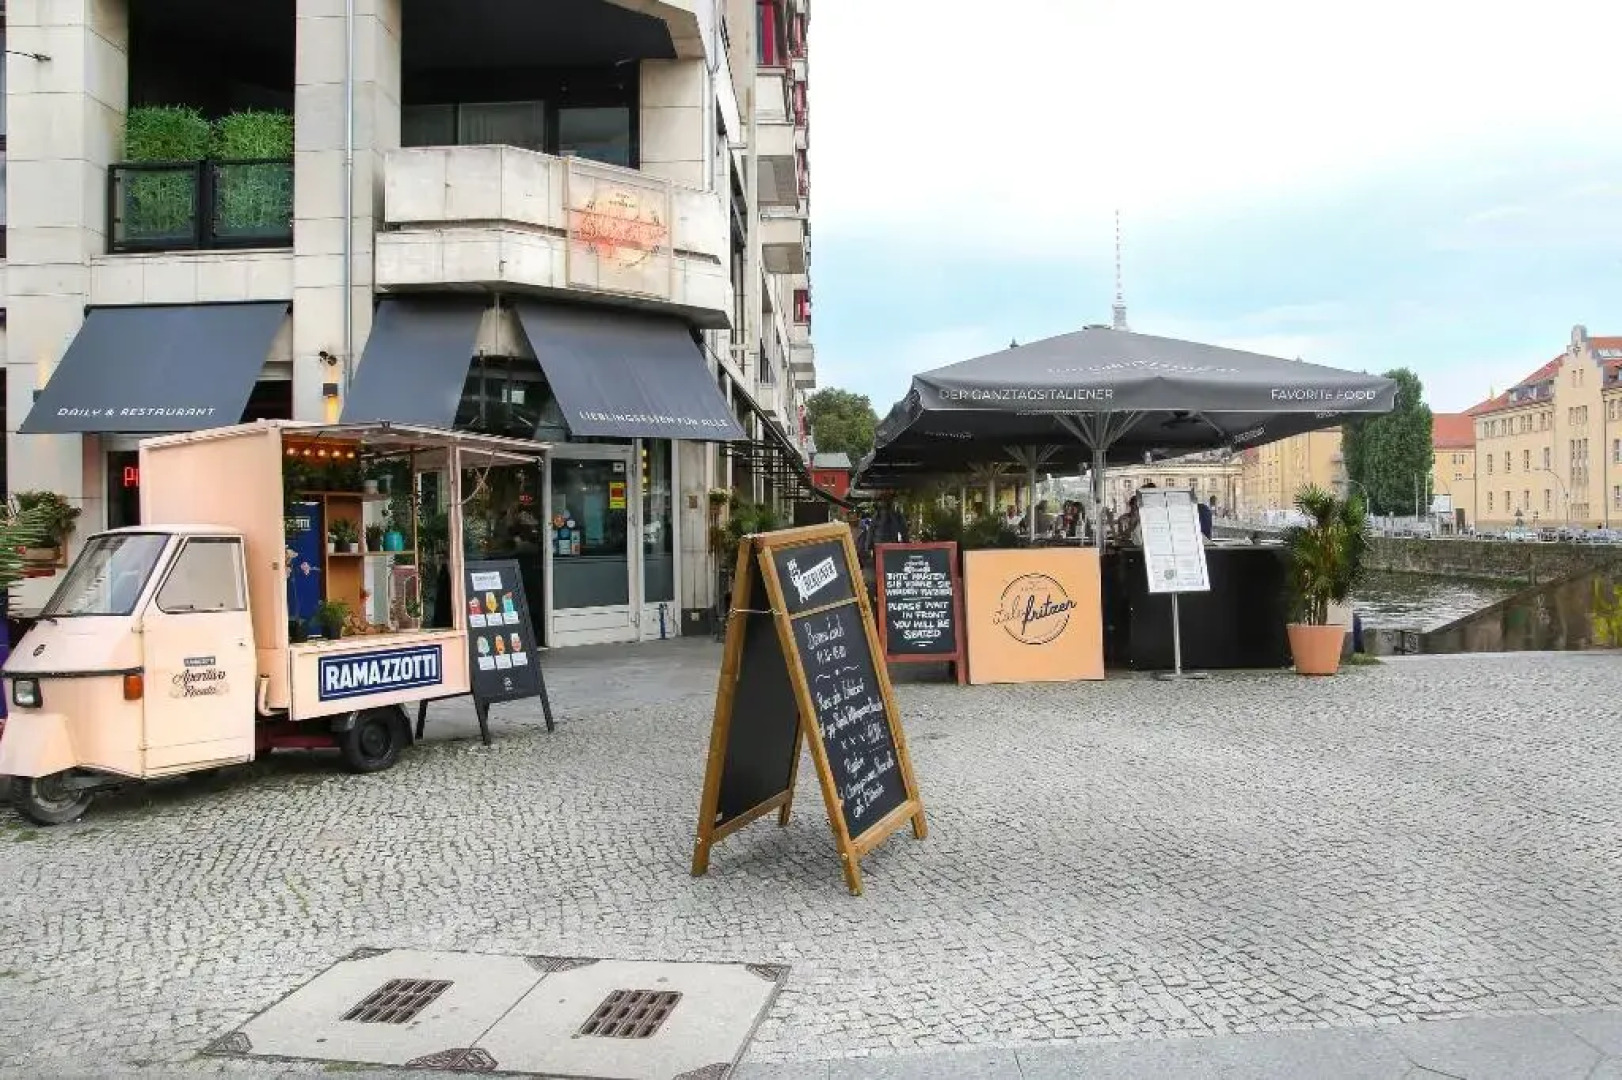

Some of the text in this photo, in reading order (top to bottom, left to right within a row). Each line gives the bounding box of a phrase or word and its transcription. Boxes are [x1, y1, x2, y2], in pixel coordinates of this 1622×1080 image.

[938, 389, 1114, 400] DER GANZTAGSITALIENER
[1271, 388, 1376, 400] FAVORITE FOOD
[56, 407, 216, 416] DAILY & RESTAURANT
[887, 601, 950, 611] PLEASE WAIT
[902, 610, 947, 619] IN FRONT
[892, 619, 950, 629] YOU WILL BE
[903, 629, 942, 639] SEATED
[325, 653, 438, 692] RAMAZZOTTI
